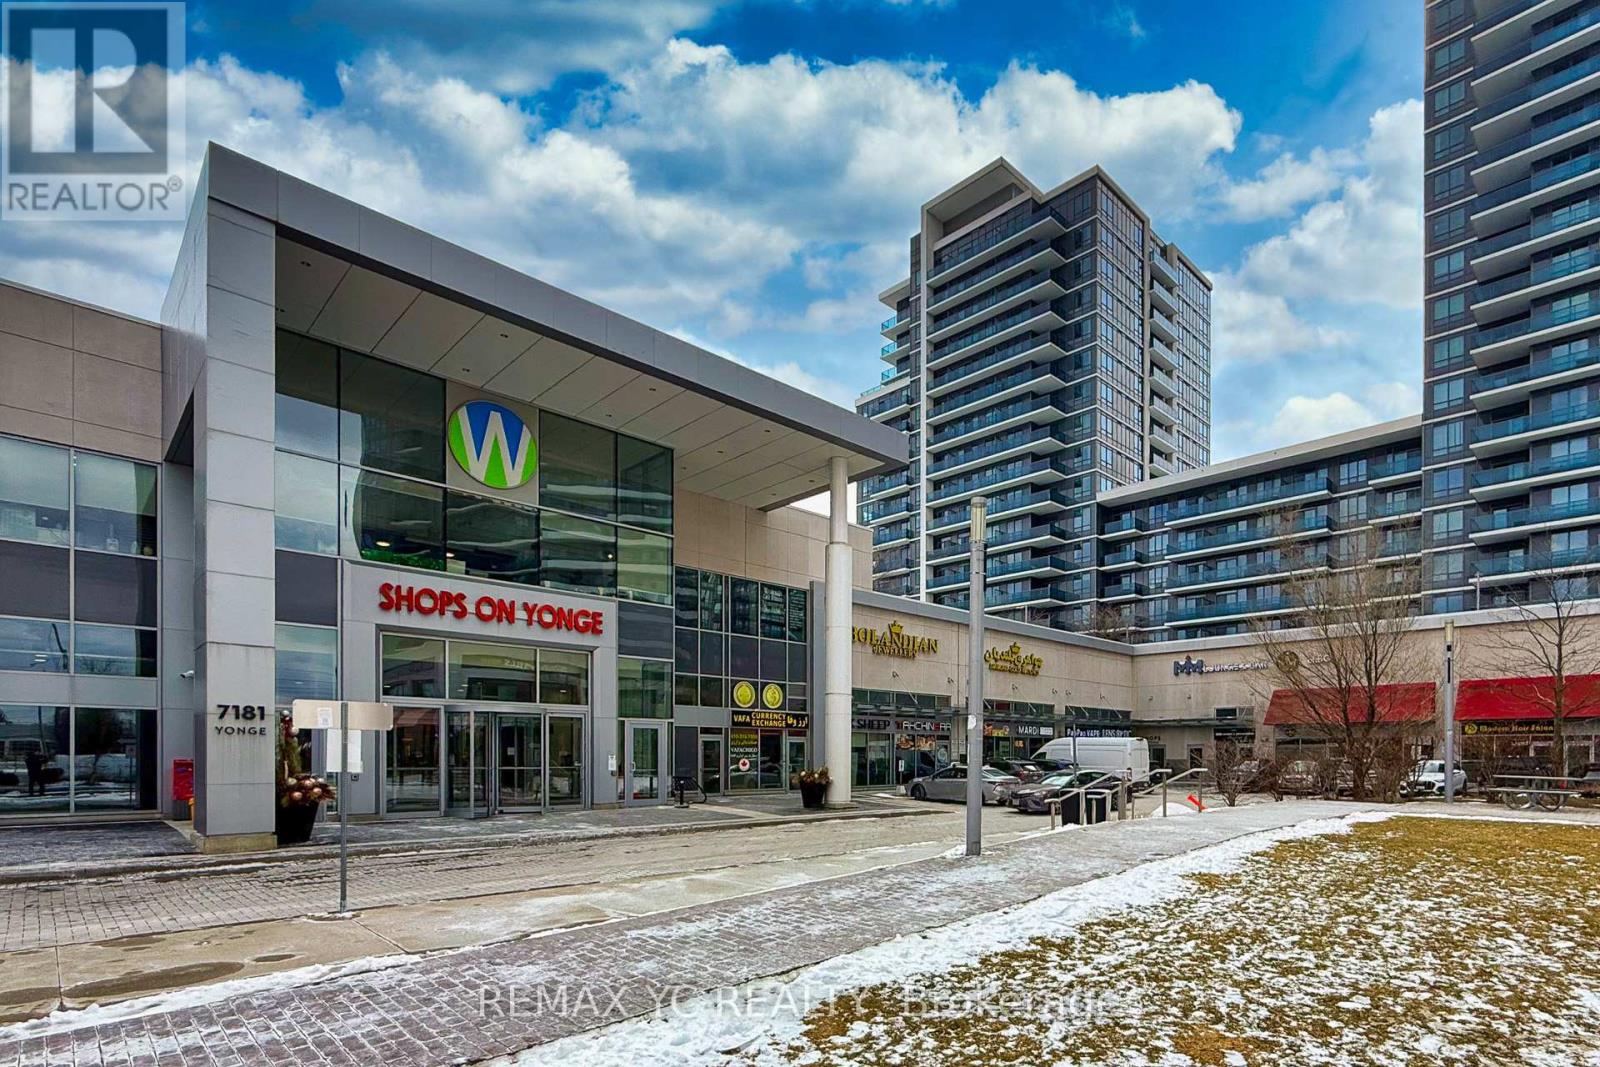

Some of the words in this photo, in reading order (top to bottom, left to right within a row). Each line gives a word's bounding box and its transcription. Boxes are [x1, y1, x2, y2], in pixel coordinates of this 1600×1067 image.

[379, 583, 468, 619] SHOPS
[475, 596, 516, 624] ON
[523, 602, 604, 635] YONGE
[216, 704, 265, 721] 7181
[751, 711, 786, 721] CURRENCY
[733, 714, 751, 723] VAFA
[751, 719, 786, 728] EXCHANGE
[856, 718, 891, 730] SHEEP
[215, 726, 266, 735] YONGE
